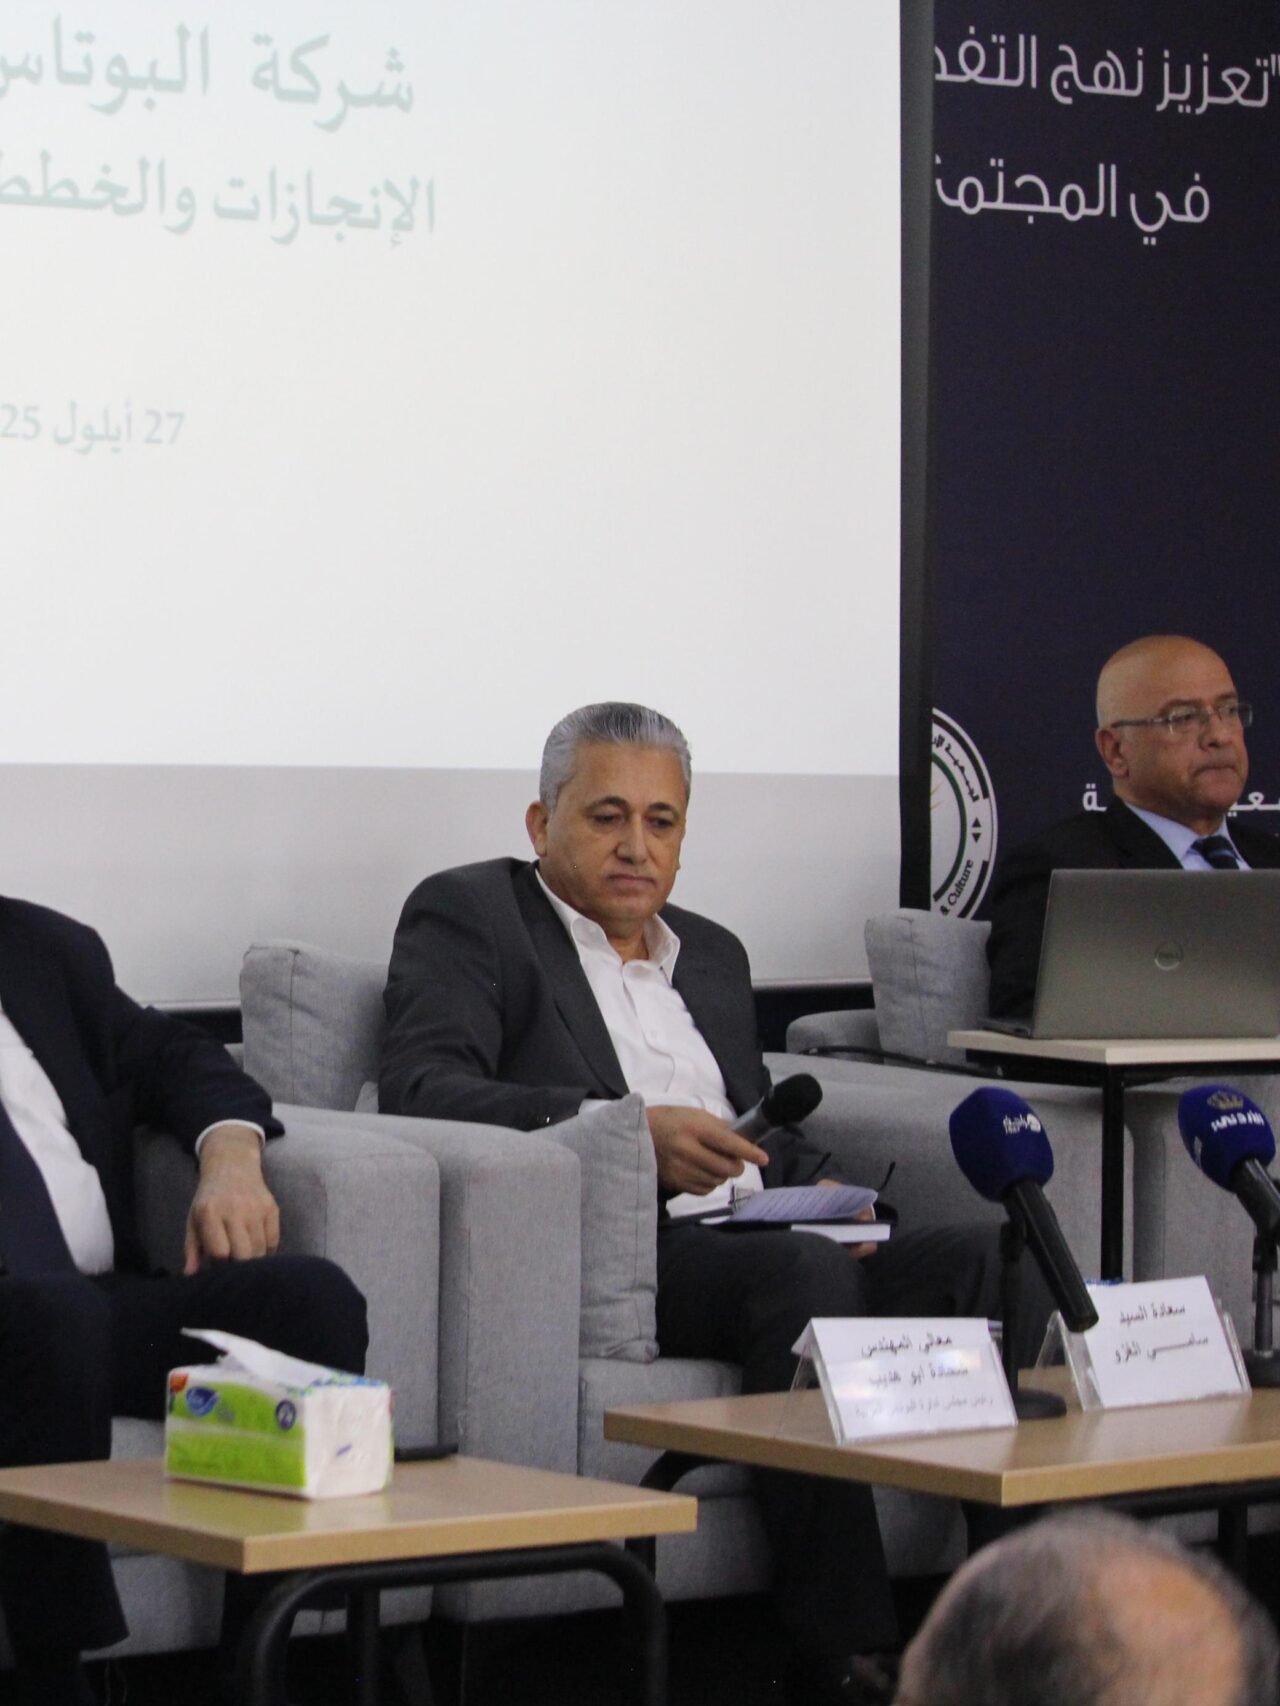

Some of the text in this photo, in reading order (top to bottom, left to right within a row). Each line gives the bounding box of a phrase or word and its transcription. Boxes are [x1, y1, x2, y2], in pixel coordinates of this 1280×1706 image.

[251, 32, 414, 133] شركة
[1051, 45, 1143, 104] نهج
[213, 165, 434, 247] الإنجازات
[1129, 172, 1210, 246] في
[53, 398, 133, 455] أيلول
[144, 408, 186, 445] 27
[947, 859, 974, 906] Culture
